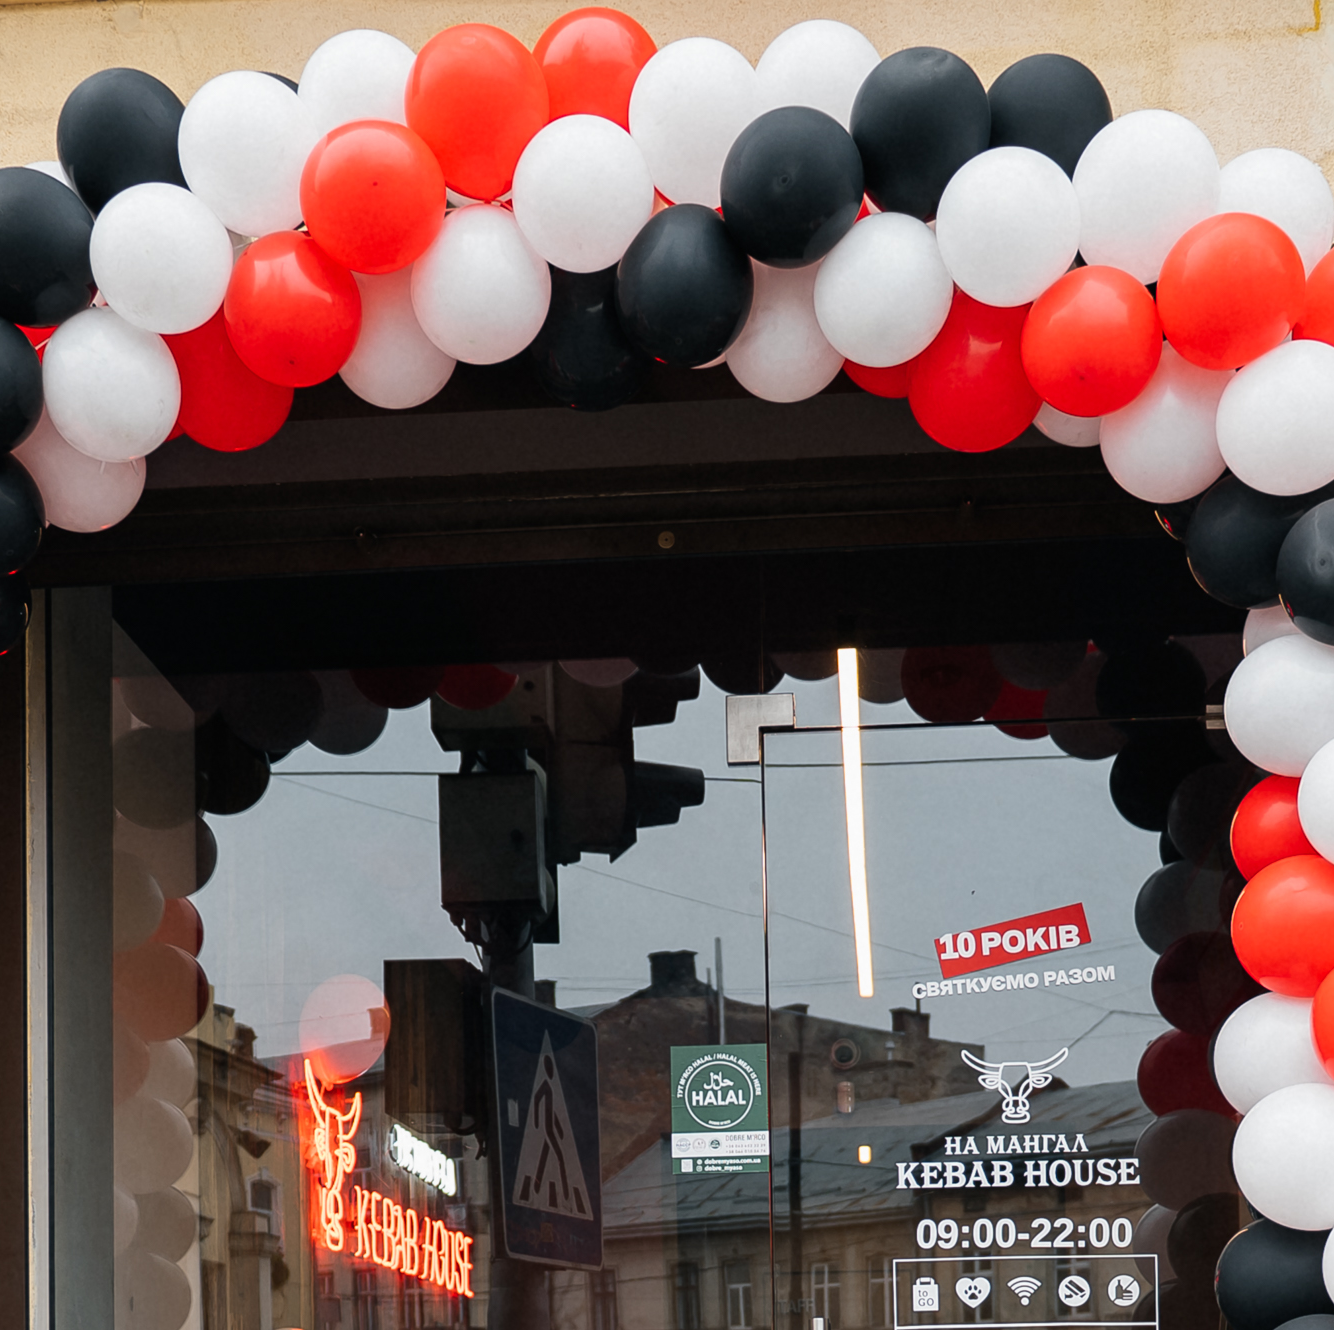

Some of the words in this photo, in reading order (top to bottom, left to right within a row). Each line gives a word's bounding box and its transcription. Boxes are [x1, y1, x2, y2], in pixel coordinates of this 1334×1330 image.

[939, 931, 976, 960] 10
[981, 924, 1080, 956] РОКІВ
[912, 972, 1039, 999] СВЯТКУЄМО
[1043, 965, 1116, 987] РАЗОМ
[691, 1089, 747, 1107] HALAL
[944, 1136, 980, 1155] НА
[986, 1133, 1089, 1155] МАНГАЛ
[895, 1160, 1014, 1189] KEBAB
[1024, 1158, 1141, 1188] HOUSE
[354, 1184, 420, 1276] KEBAB
[419, 1216, 475, 1298] HOUSE
[916, 1217, 1133, 1250] 09:00-22:00
[918, 1289, 929, 1298] to
[918, 1298, 935, 1307] GO
